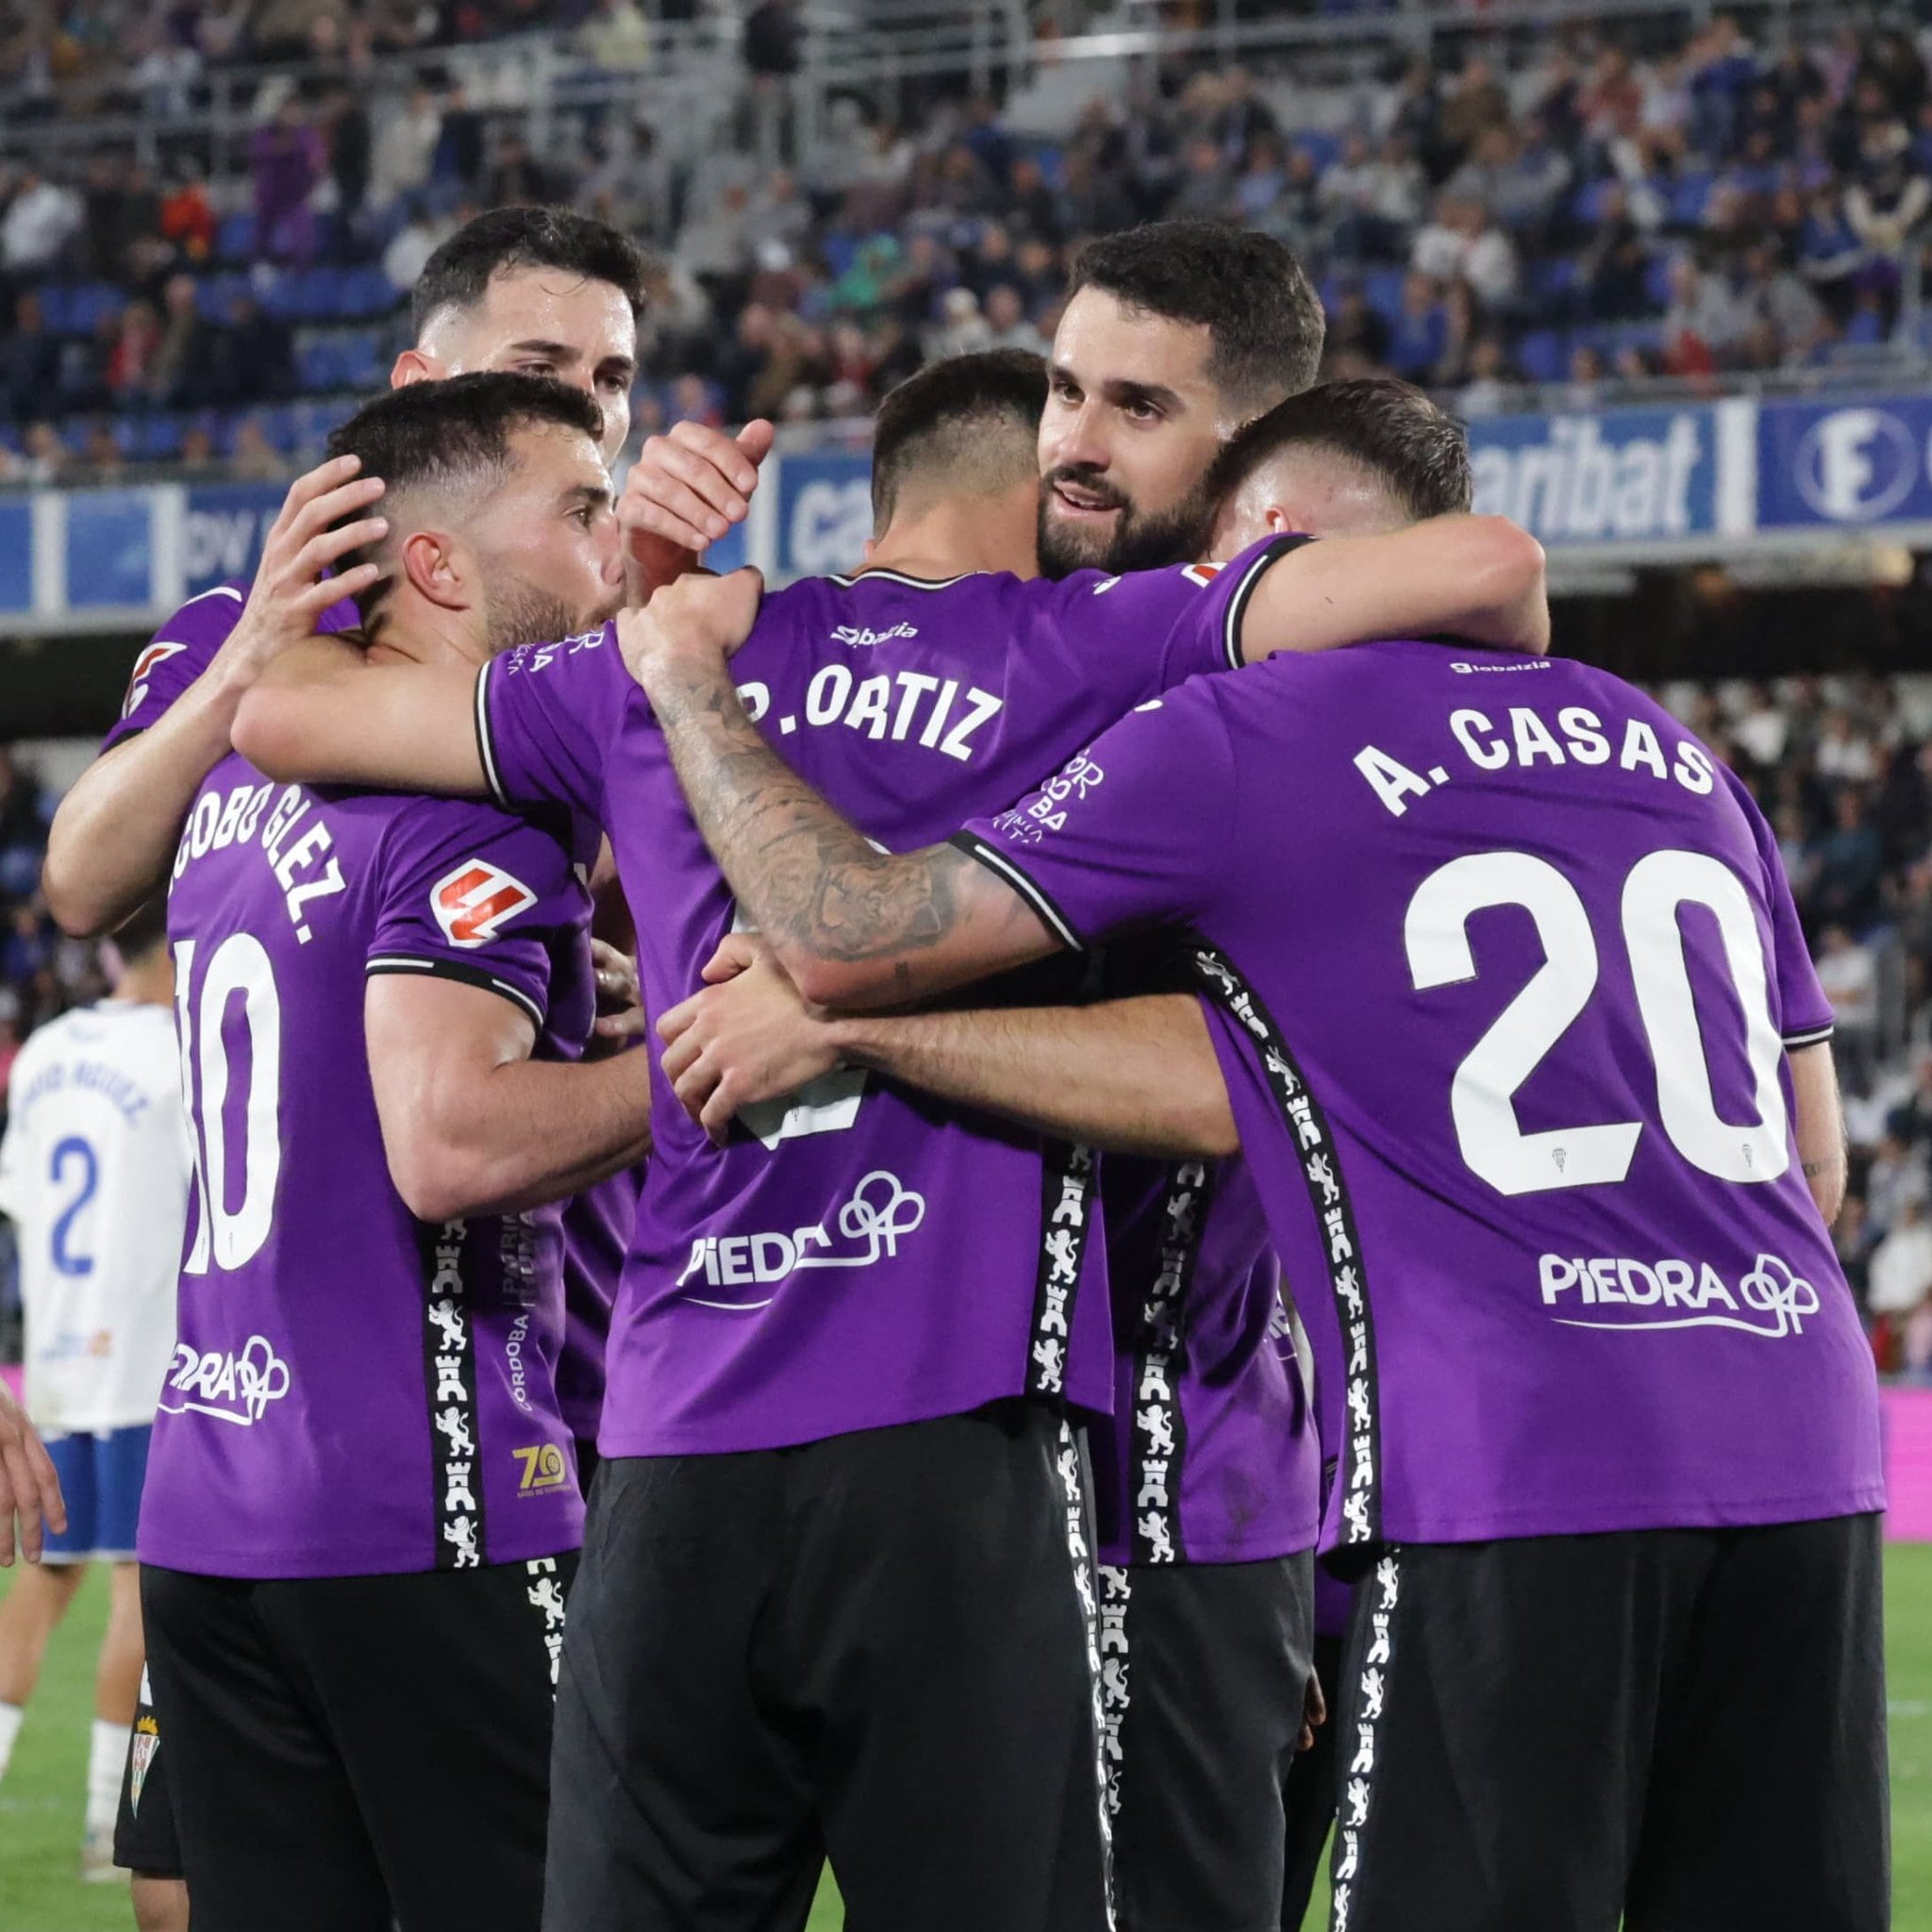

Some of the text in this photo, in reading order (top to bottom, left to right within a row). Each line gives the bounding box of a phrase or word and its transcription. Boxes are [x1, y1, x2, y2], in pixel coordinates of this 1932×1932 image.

[1353, 707, 1715, 818] A. CASAS
[173, 931, 281, 1276] 10
[1404, 849, 1790, 1196] 20
[50, 1136, 99, 1276] 2
